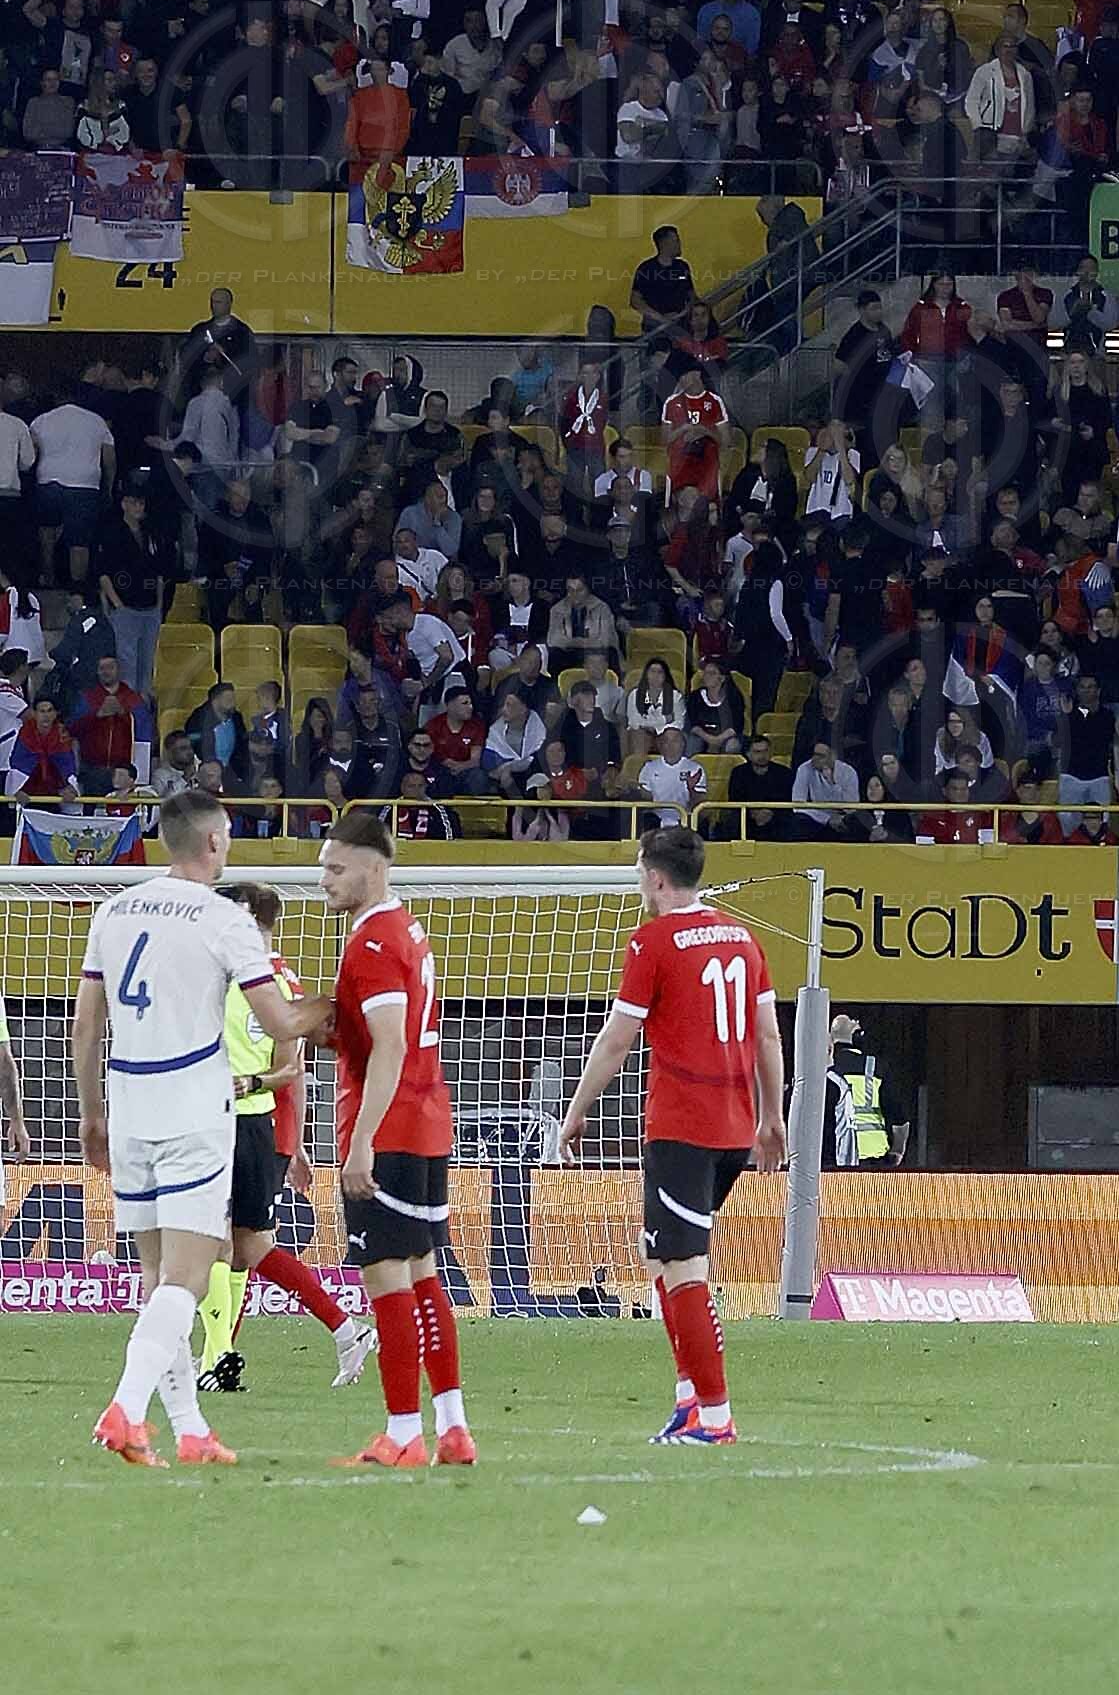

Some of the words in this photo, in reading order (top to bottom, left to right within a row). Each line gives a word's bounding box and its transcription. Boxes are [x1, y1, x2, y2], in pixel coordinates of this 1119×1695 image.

[117, 930, 152, 1021] 4
[700, 954, 747, 1044] 11
[869, 1278, 1029, 1321] Magenta
